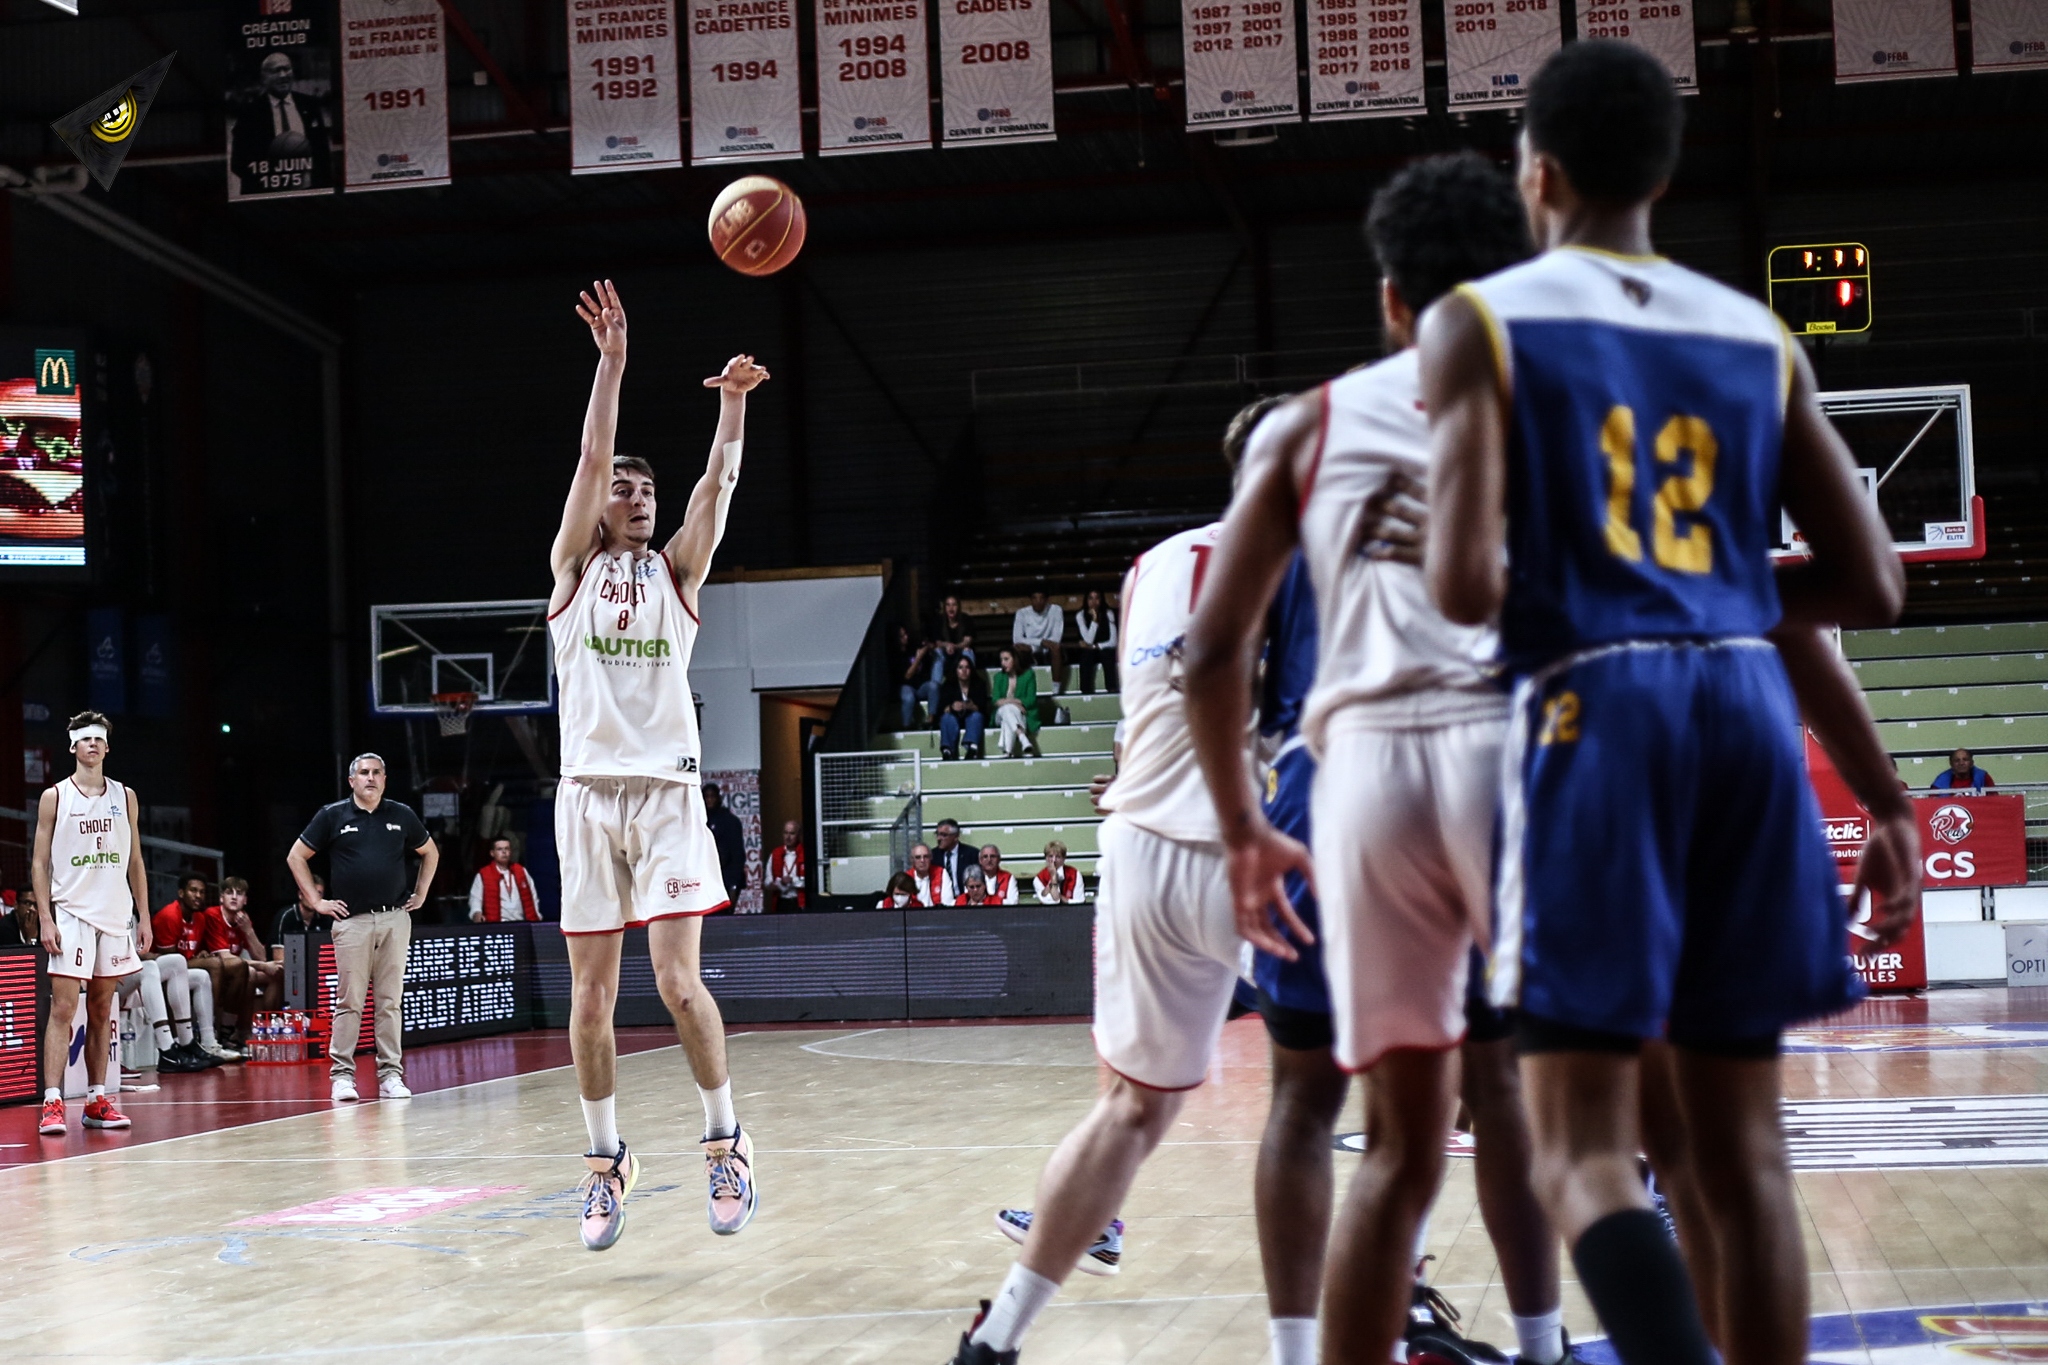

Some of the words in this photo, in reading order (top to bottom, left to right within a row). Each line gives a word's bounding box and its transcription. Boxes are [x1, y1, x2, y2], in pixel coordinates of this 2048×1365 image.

[695, 9, 712, 19] DE
[717, 0, 788, 18] FRANCE
[824, 5, 917, 26] MINIMES
[956, 0, 1032, 14] CADETS
[1192, 5, 1231, 20] 1987
[1242, 1, 1282, 16] 1990
[1454, 3, 1495, 16] 2001
[1588, 9, 1629, 23] 2010
[1640, 5, 1680, 19] 2018
[348, 14, 437, 30] CHAMPIONNE
[575, 17, 592, 27] DE
[598, 7, 667, 25] FRANCE
[694, 15, 790, 35] CADETTES
[1317, 12, 1357, 26] 1995
[1368, 9, 1408, 22] 1997
[242, 18, 311, 36] CRÉATION
[576, 24, 668, 43] MINIMES
[1192, 21, 1232, 36] 1997
[1242, 18, 1283, 33] 2001
[1369, 26, 1409, 39] 2000
[1455, 19, 1496, 33] 2019
[1588, 25, 1629, 38] 2019
[246, 36, 267, 48] DU
[270, 33, 307, 46] CLUB
[349, 35, 365, 46] DE
[369, 27, 437, 45] FRANCE
[1193, 38, 1233, 53] 2012
[1243, 34, 1283, 49] 2017
[349, 44, 421, 59] NATIONALE
[425, 43, 439, 53] IV
[838, 34, 906, 57] 1994
[961, 40, 1030, 64] 2008
[1318, 45, 1358, 59] 2001
[1369, 42, 1410, 56] 2015
[2024, 41, 2046, 52] FFBB
[1887, 51, 1908, 61] FFBB
[590, 54, 655, 77] 1991
[711, 59, 778, 82] 1994
[839, 58, 907, 81] 2008
[1319, 62, 1359, 75] 2017
[1370, 58, 1410, 72] 2018
[591, 78, 657, 100] 1992
[1454, 90, 1489, 100] CENTRE
[1492, 90, 1503, 98] DE
[364, 87, 426, 110] 1991
[1316, 101, 1350, 110] CENTRE
[1353, 99, 1364, 108] DE
[1367, 96, 1419, 107] FORMATION
[1192, 110, 1226, 120] CENTRE
[1228, 109, 1239, 117] DE
[1243, 104, 1294, 115] FORMATION
[848, 133, 903, 143] ASSOCIATION
[948, 127, 980, 137] CENTRE
[985, 125, 996, 134] DE
[999, 122, 1049, 133] FORMATION
[720, 142, 774, 153] ASSOCIATION
[247, 160, 269, 174] 18
[274, 157, 313, 171] JUIN
[259, 172, 302, 188] 1975
[1601, 404, 1718, 574] 12
[617, 609, 629, 631] 8
[585, 632, 671, 658] AUTIER
[1541, 690, 1580, 746] 12
[79, 818, 112, 835] CHOLET
[1826, 822, 1864, 839] tclic
[96, 836, 103, 850] 6
[1925, 851, 1976, 879] CS
[667, 881, 679, 894] CB
[75, 947, 83, 966] 6
